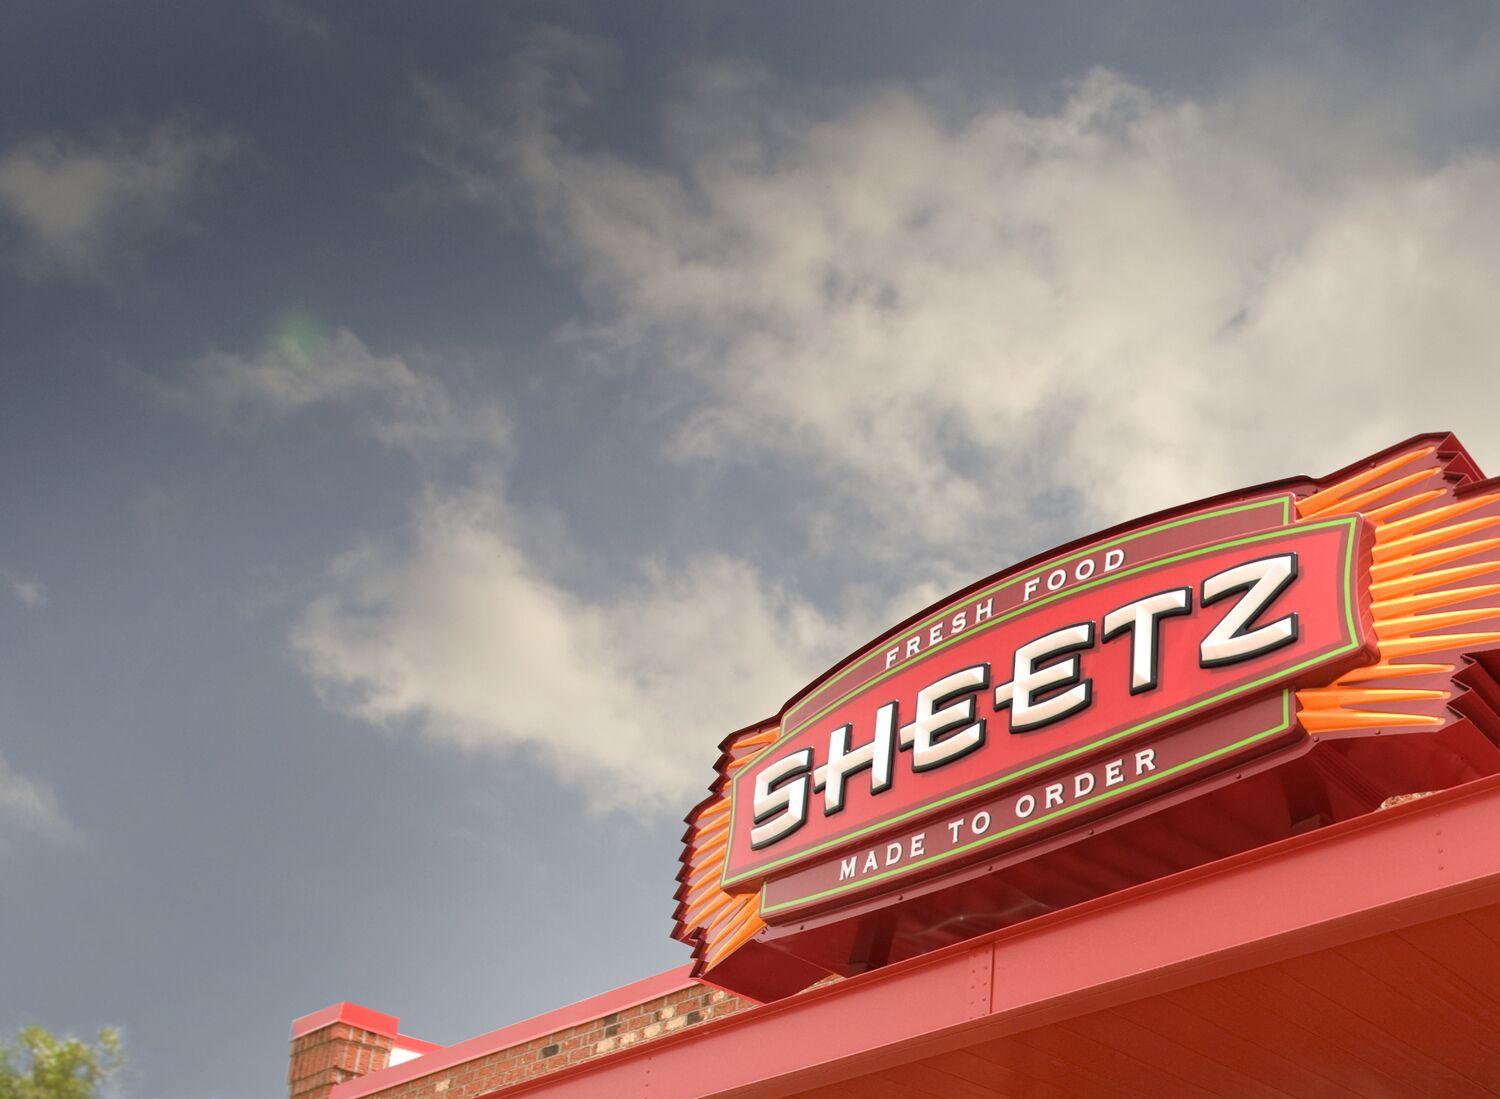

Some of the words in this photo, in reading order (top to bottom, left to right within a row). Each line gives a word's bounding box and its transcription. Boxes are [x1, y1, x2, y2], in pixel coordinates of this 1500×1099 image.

[885, 598, 995, 670] FRESH
[1023, 548, 1126, 602] FOOD
[749, 551, 1298, 850] SHEETZ
[838, 832, 926, 881] MADE
[948, 811, 992, 844] TO
[1015, 748, 1157, 819] ORDER
